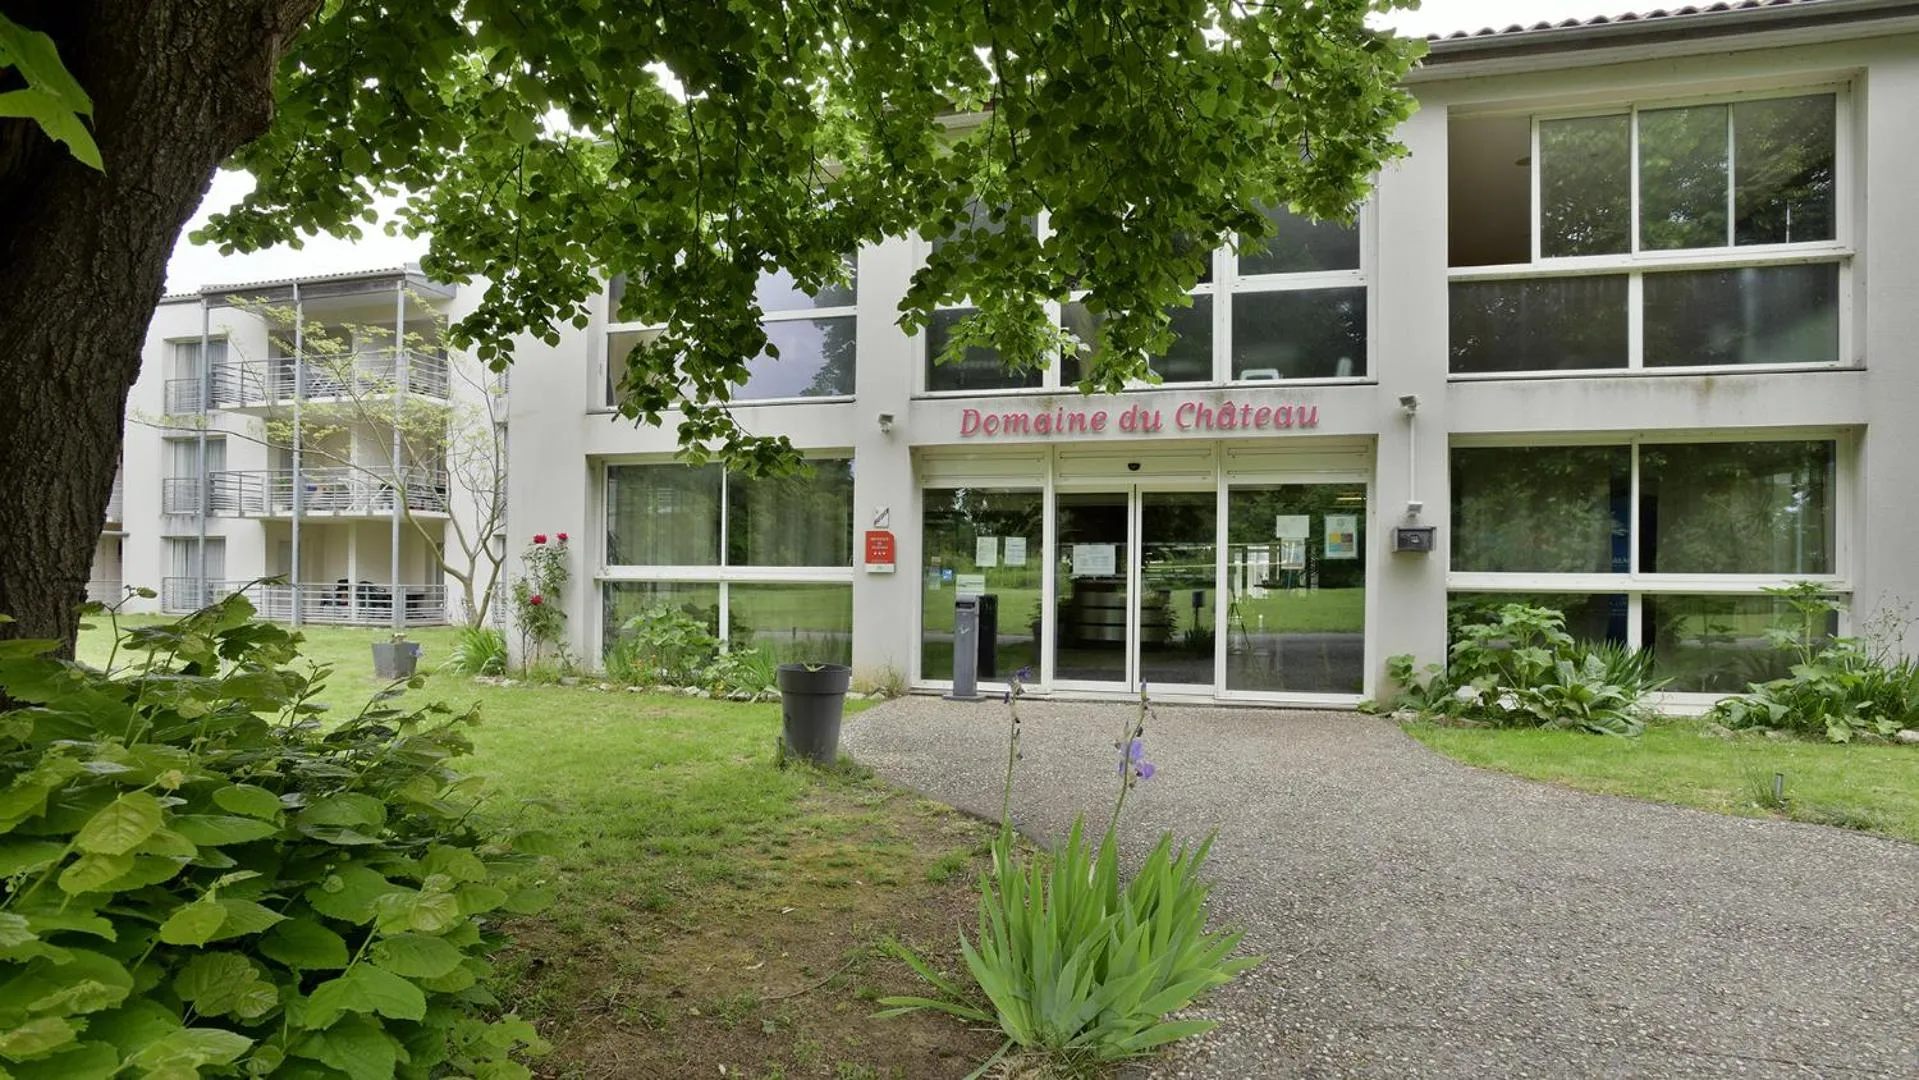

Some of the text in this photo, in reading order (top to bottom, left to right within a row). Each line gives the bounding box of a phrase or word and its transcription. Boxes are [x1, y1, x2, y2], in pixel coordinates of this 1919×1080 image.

[960, 401, 1319, 437] Domaine du Château
